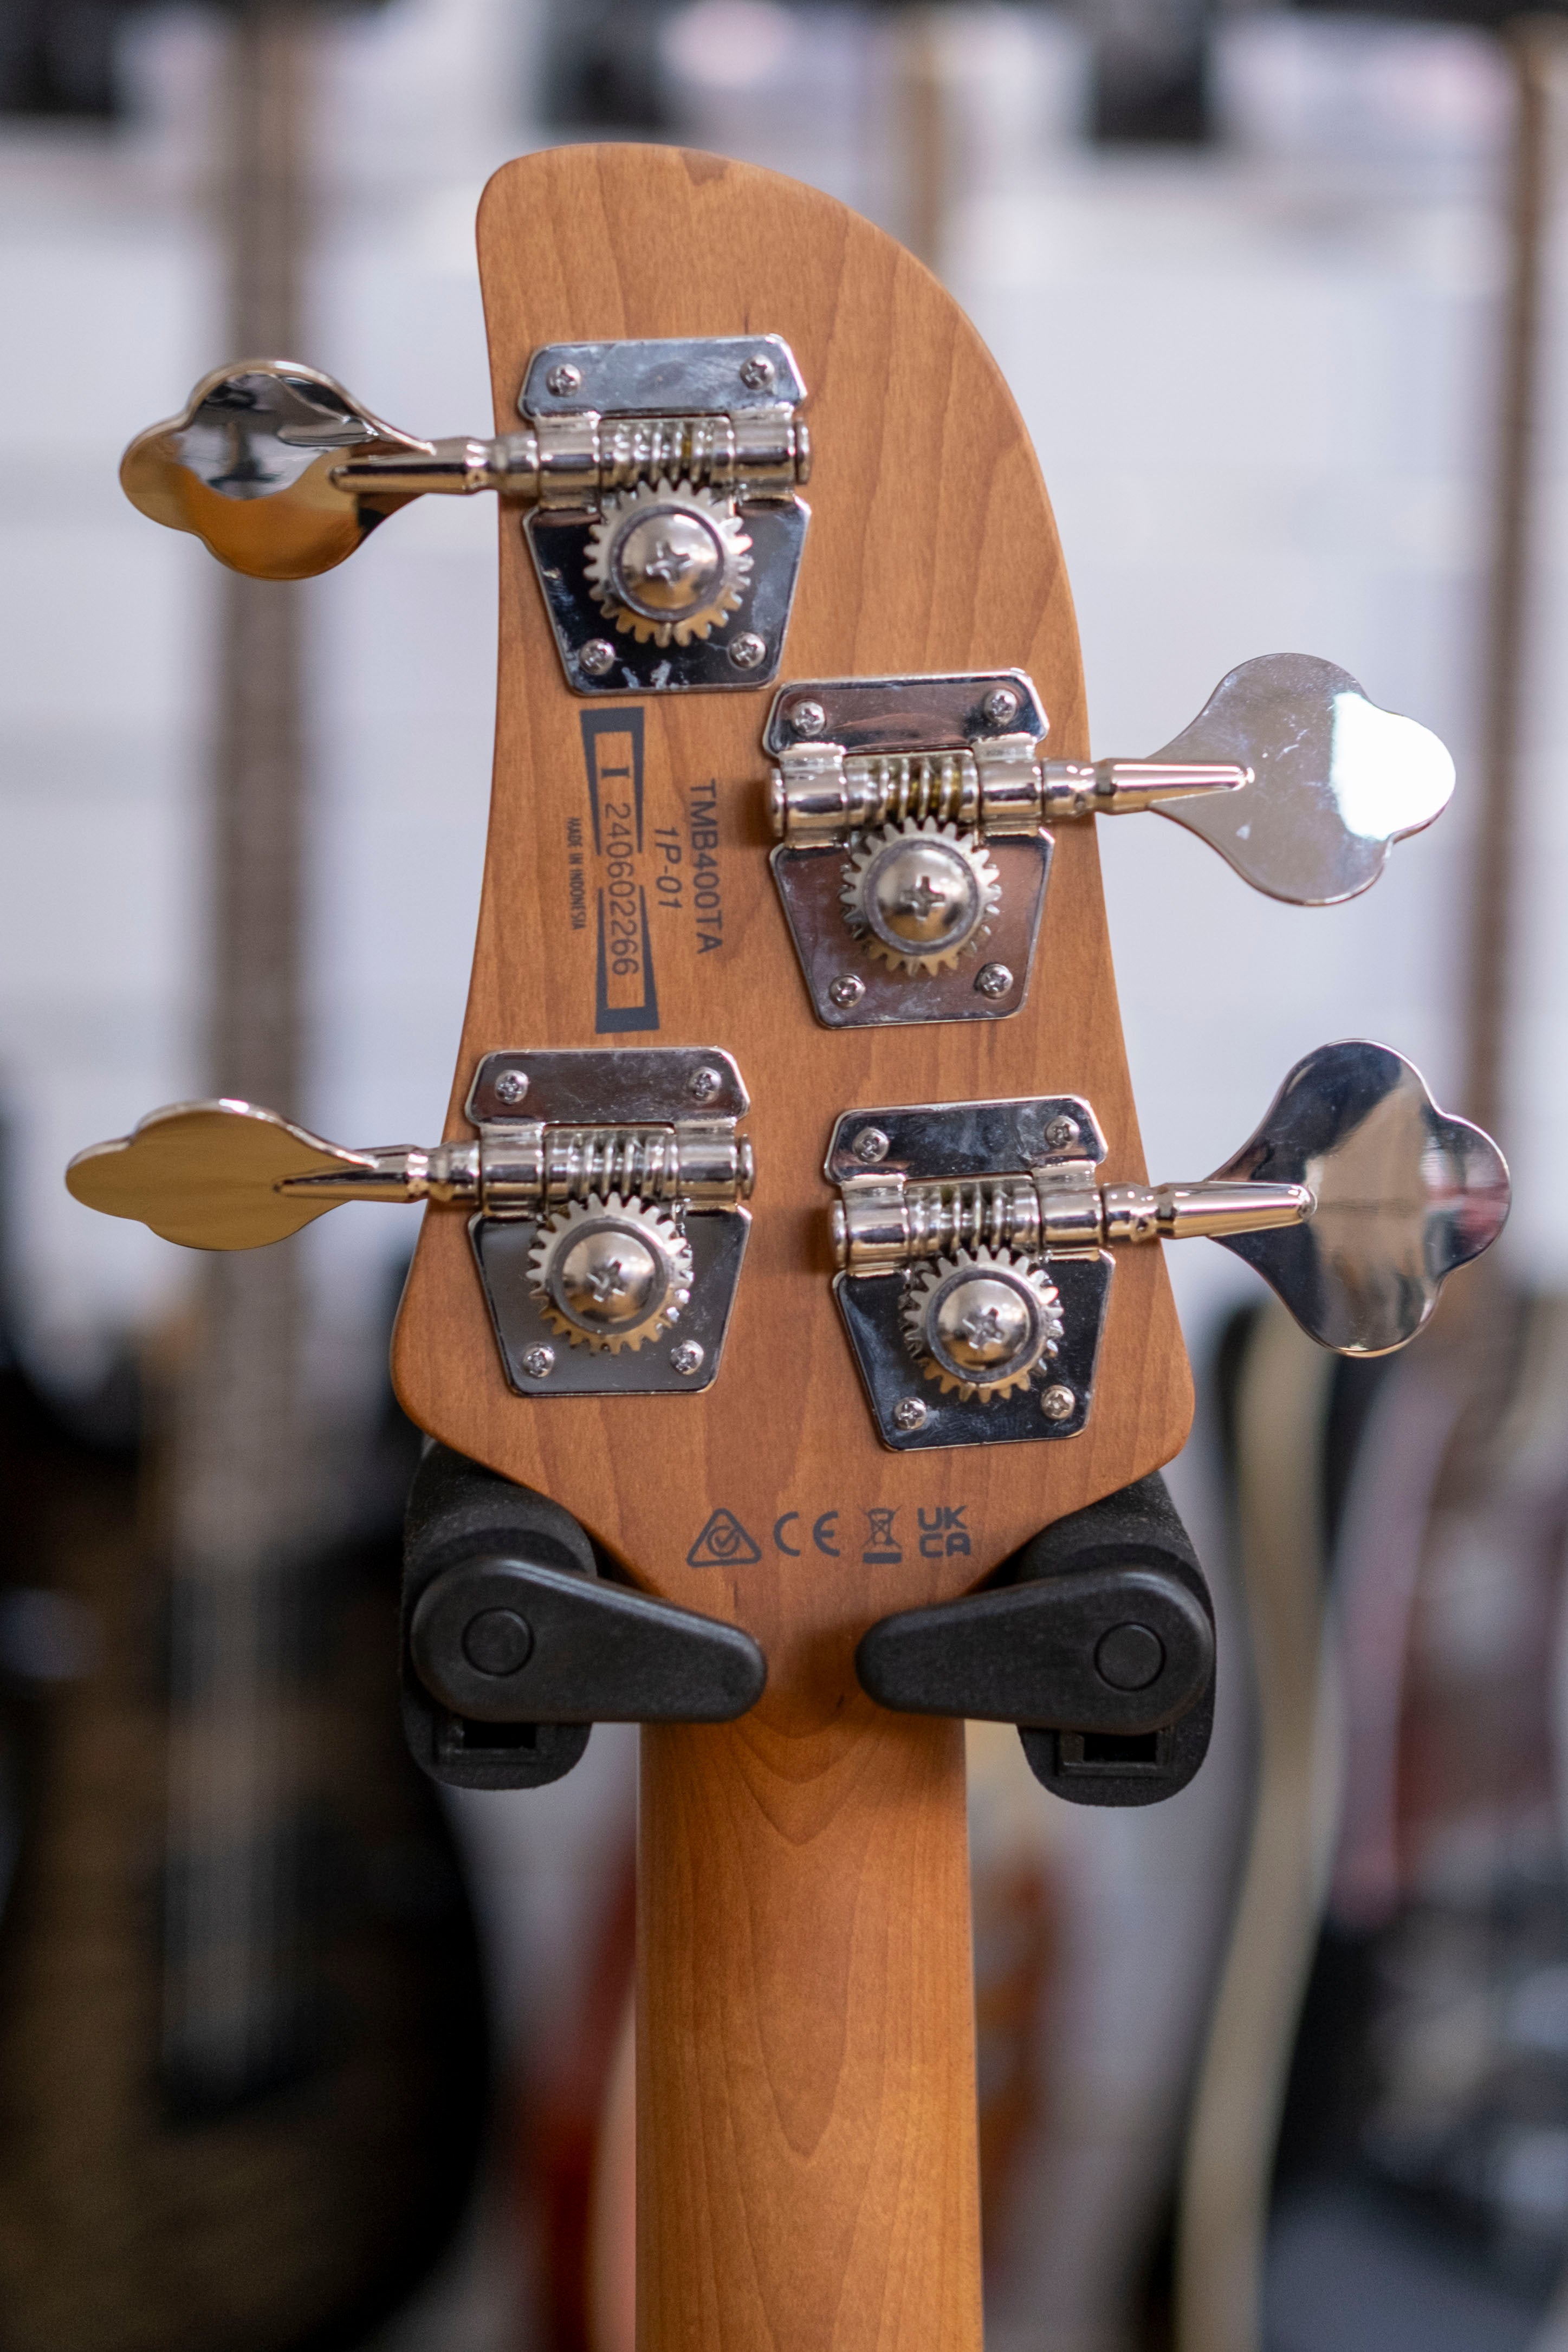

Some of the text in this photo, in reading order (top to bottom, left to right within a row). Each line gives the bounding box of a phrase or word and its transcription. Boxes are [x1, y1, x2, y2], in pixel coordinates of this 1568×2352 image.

[567, 817, 586, 930] MADE IN INDONESIA
[601, 766, 639, 976] I 240602266
[654, 826, 683, 909] 1P-01
[690, 778, 723, 954] TMB400TA
[773, 1511, 840, 1557] CE
[917, 1505, 967, 1532] UK
[919, 1532, 971, 1558] CA
